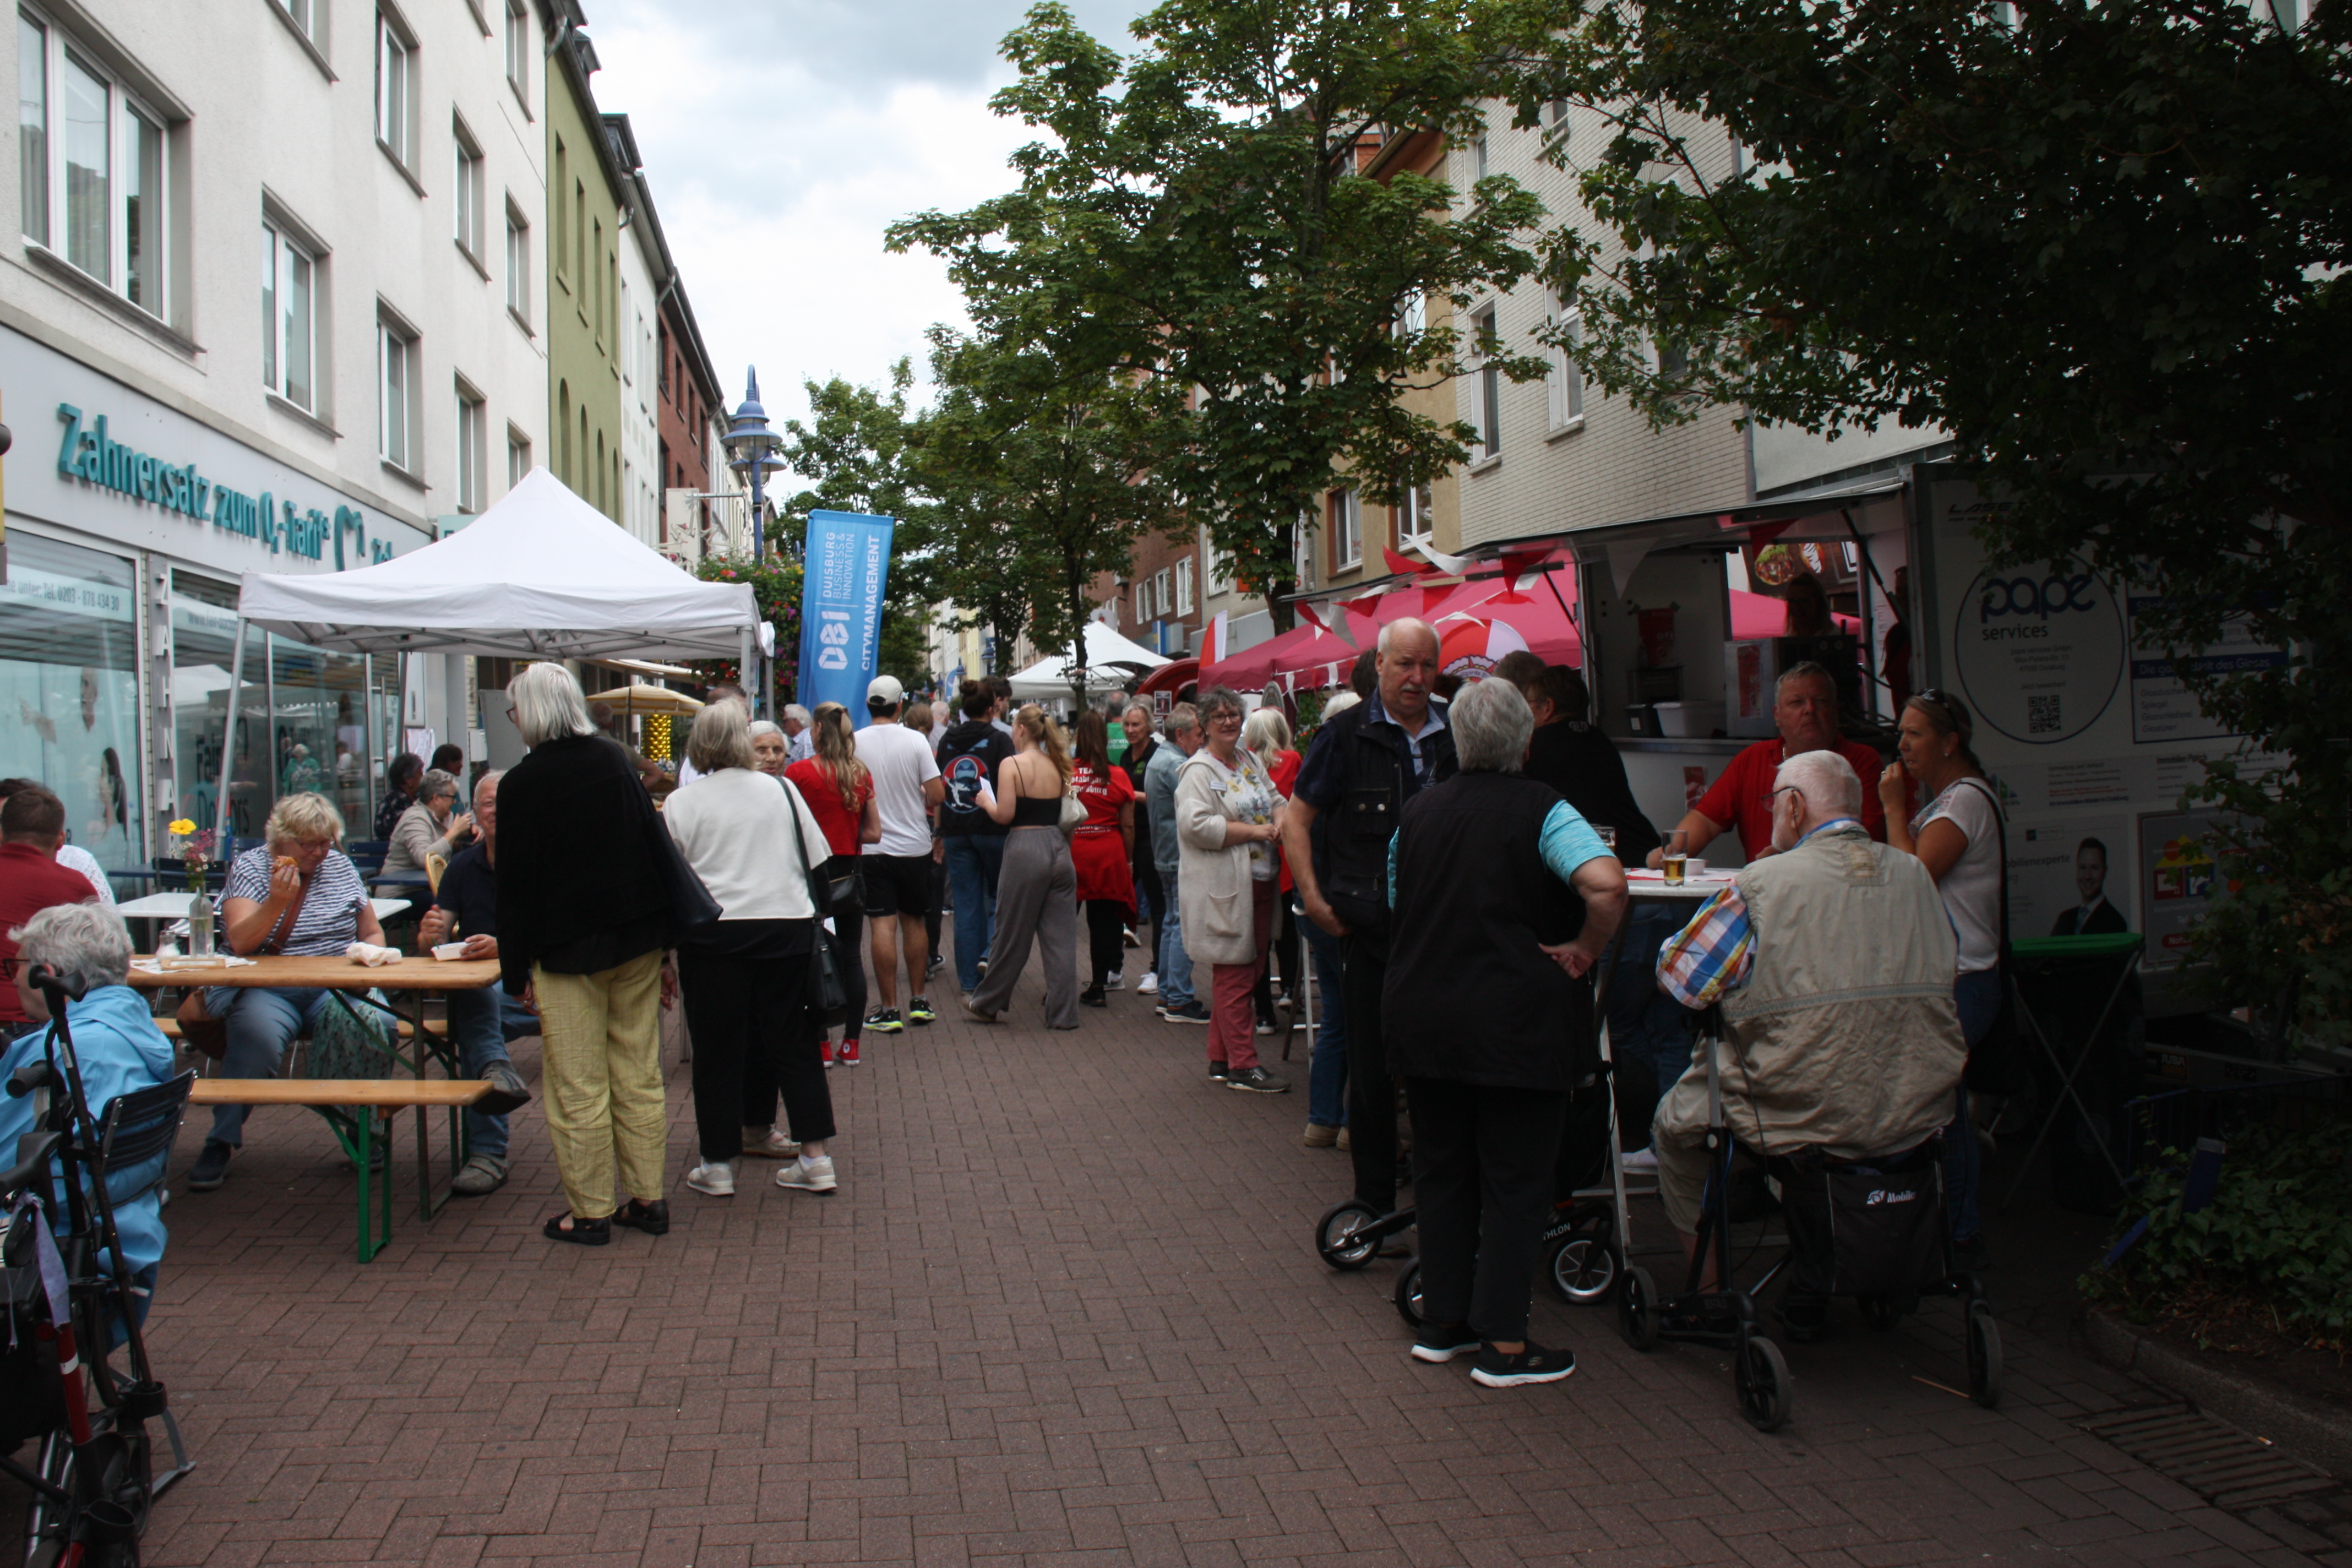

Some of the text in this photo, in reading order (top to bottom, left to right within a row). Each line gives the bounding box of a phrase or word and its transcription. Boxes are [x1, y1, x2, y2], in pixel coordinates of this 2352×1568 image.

[59, 402, 211, 521] Zahnersatz
[215, 485, 258, 538] zum
[1948, 501, 2028, 514] LASE
[823, 532, 836, 598] DUISBURG
[833, 544, 845, 599] BUSINESS
[842, 533, 855, 600] INNOVATION
[57, 585, 76, 603] 0203
[83, 590, 96, 607] 878
[111, 596, 119, 611] 30
[861, 535, 880, 671] CITYMANAGEMENT
[1980, 574, 2095, 624] pape
[818, 611, 851, 670] DBI
[1982, 624, 2048, 640] services
[2139, 664, 2155, 675] Die
[2215, 657, 2234, 670] des
[2140, 700, 2168, 710] Spiegel
[2006, 854, 2071, 868] obilienexperte
[1887, 1190, 1917, 1204] Mobile
[1543, 1222, 1571, 1242] THLON
